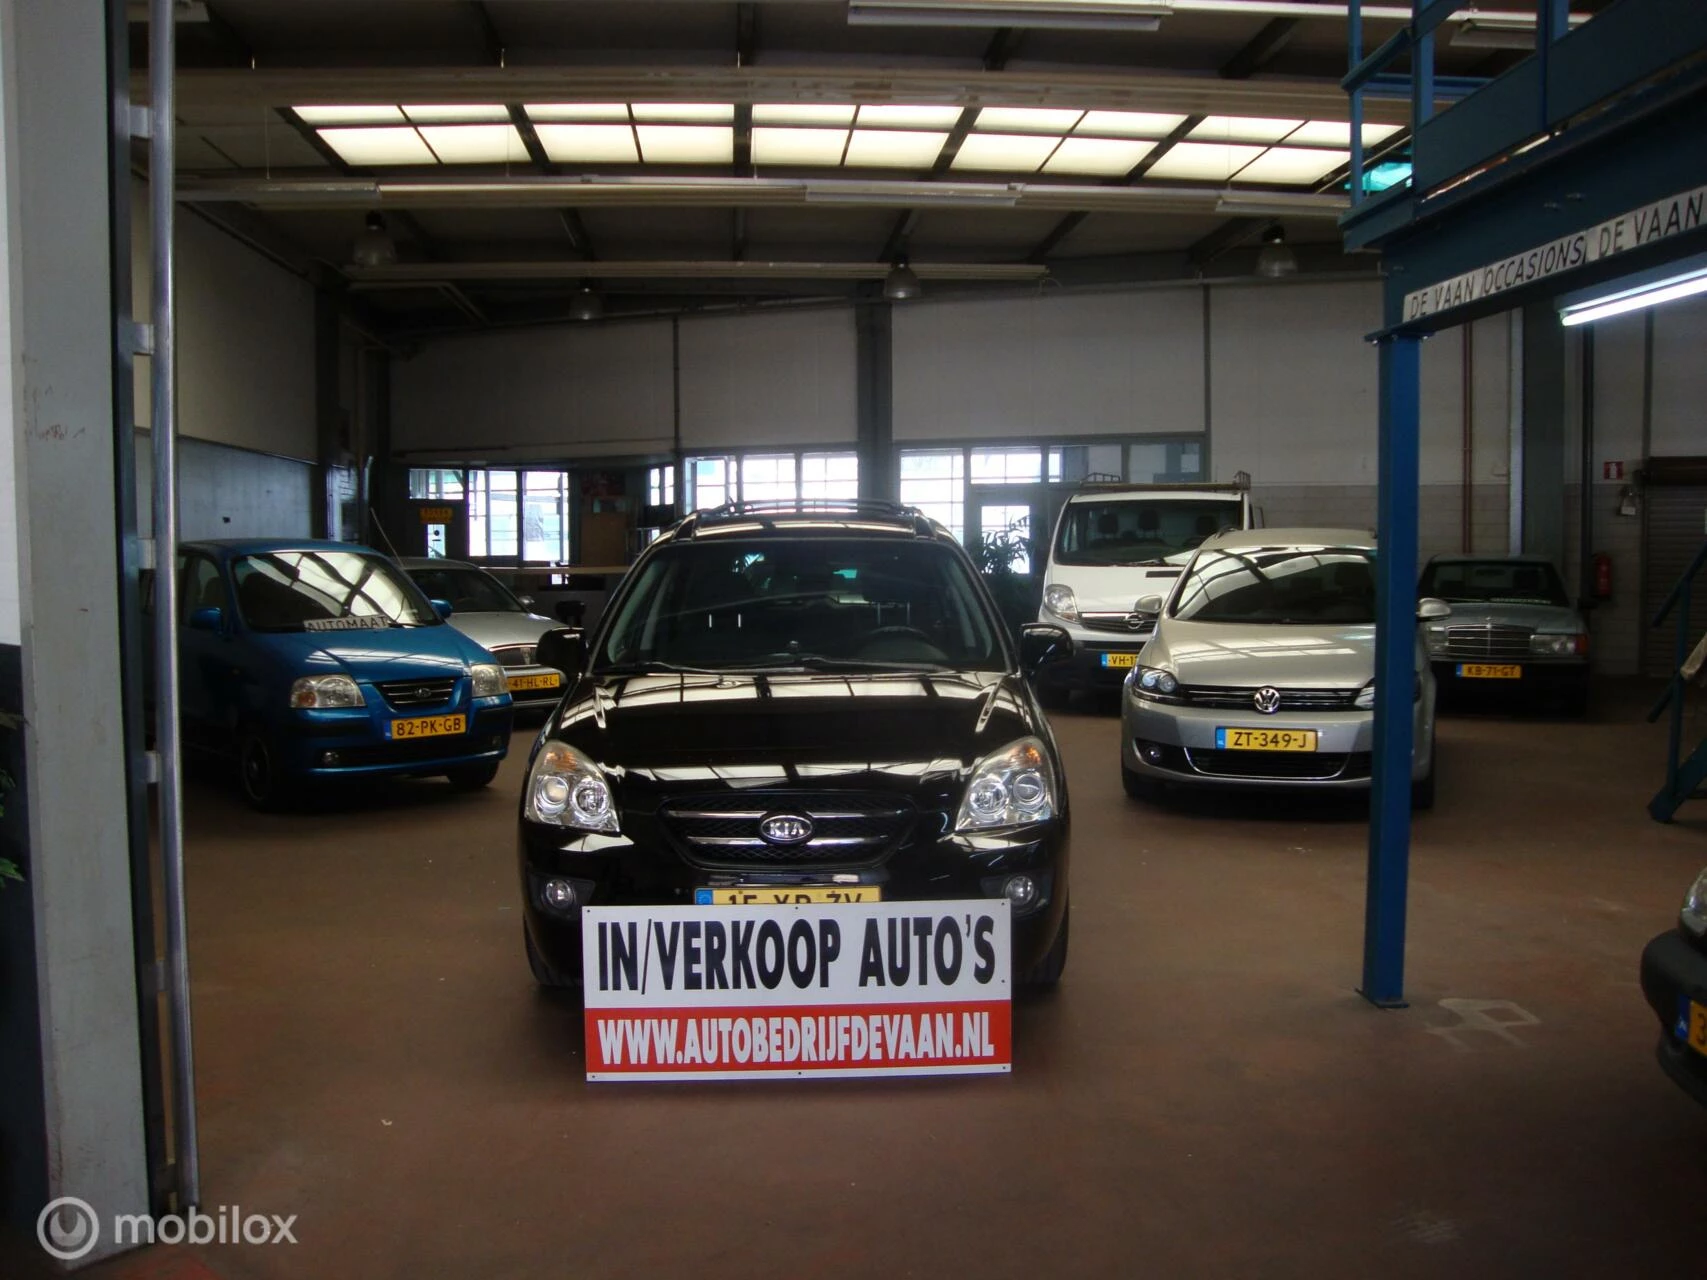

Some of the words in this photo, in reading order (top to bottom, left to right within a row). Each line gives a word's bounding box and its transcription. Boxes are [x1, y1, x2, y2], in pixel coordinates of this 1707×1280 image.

[1410, 292, 1428, 319] DE
[1435, 275, 1475, 311] VAAN
[1483, 236, 1584, 292] OCCASIONS
[1599, 220, 1625, 257] DE
[1634, 191, 1704, 245] VAAN
[305, 615, 388, 631] AUTOMAAT
[396, 718, 462, 736] 82-PK-GB
[1233, 731, 1307, 748] ZT-349-J
[769, 821, 804, 837] KIA
[597, 918, 841, 995] IN/VERKOOP
[859, 915, 996, 988] AUTO'S
[597, 1012, 995, 1065] WWW.AUTOBEDRIJFDEVAAN.NL
